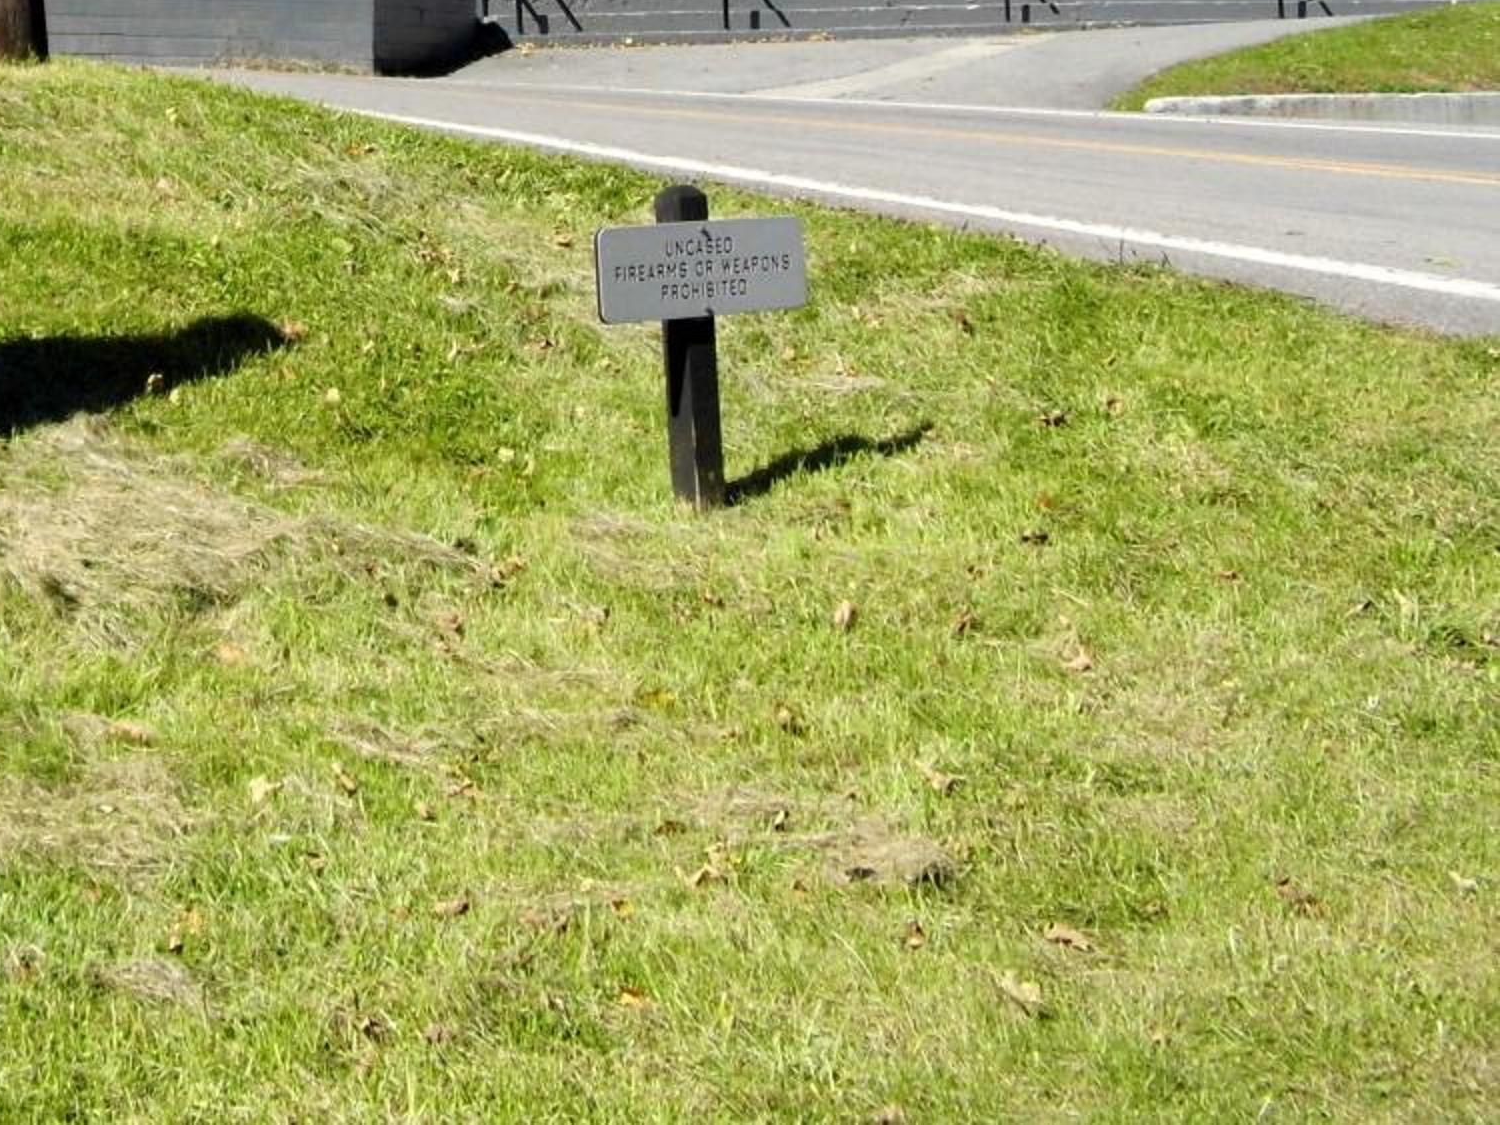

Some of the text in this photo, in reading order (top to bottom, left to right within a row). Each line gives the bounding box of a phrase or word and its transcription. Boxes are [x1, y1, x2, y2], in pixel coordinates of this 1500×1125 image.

[665, 236, 733, 257] UNCASED
[615, 254, 790, 283] FIREARMS OR WEAPONS
[661, 278, 748, 300] PROHIBITED
